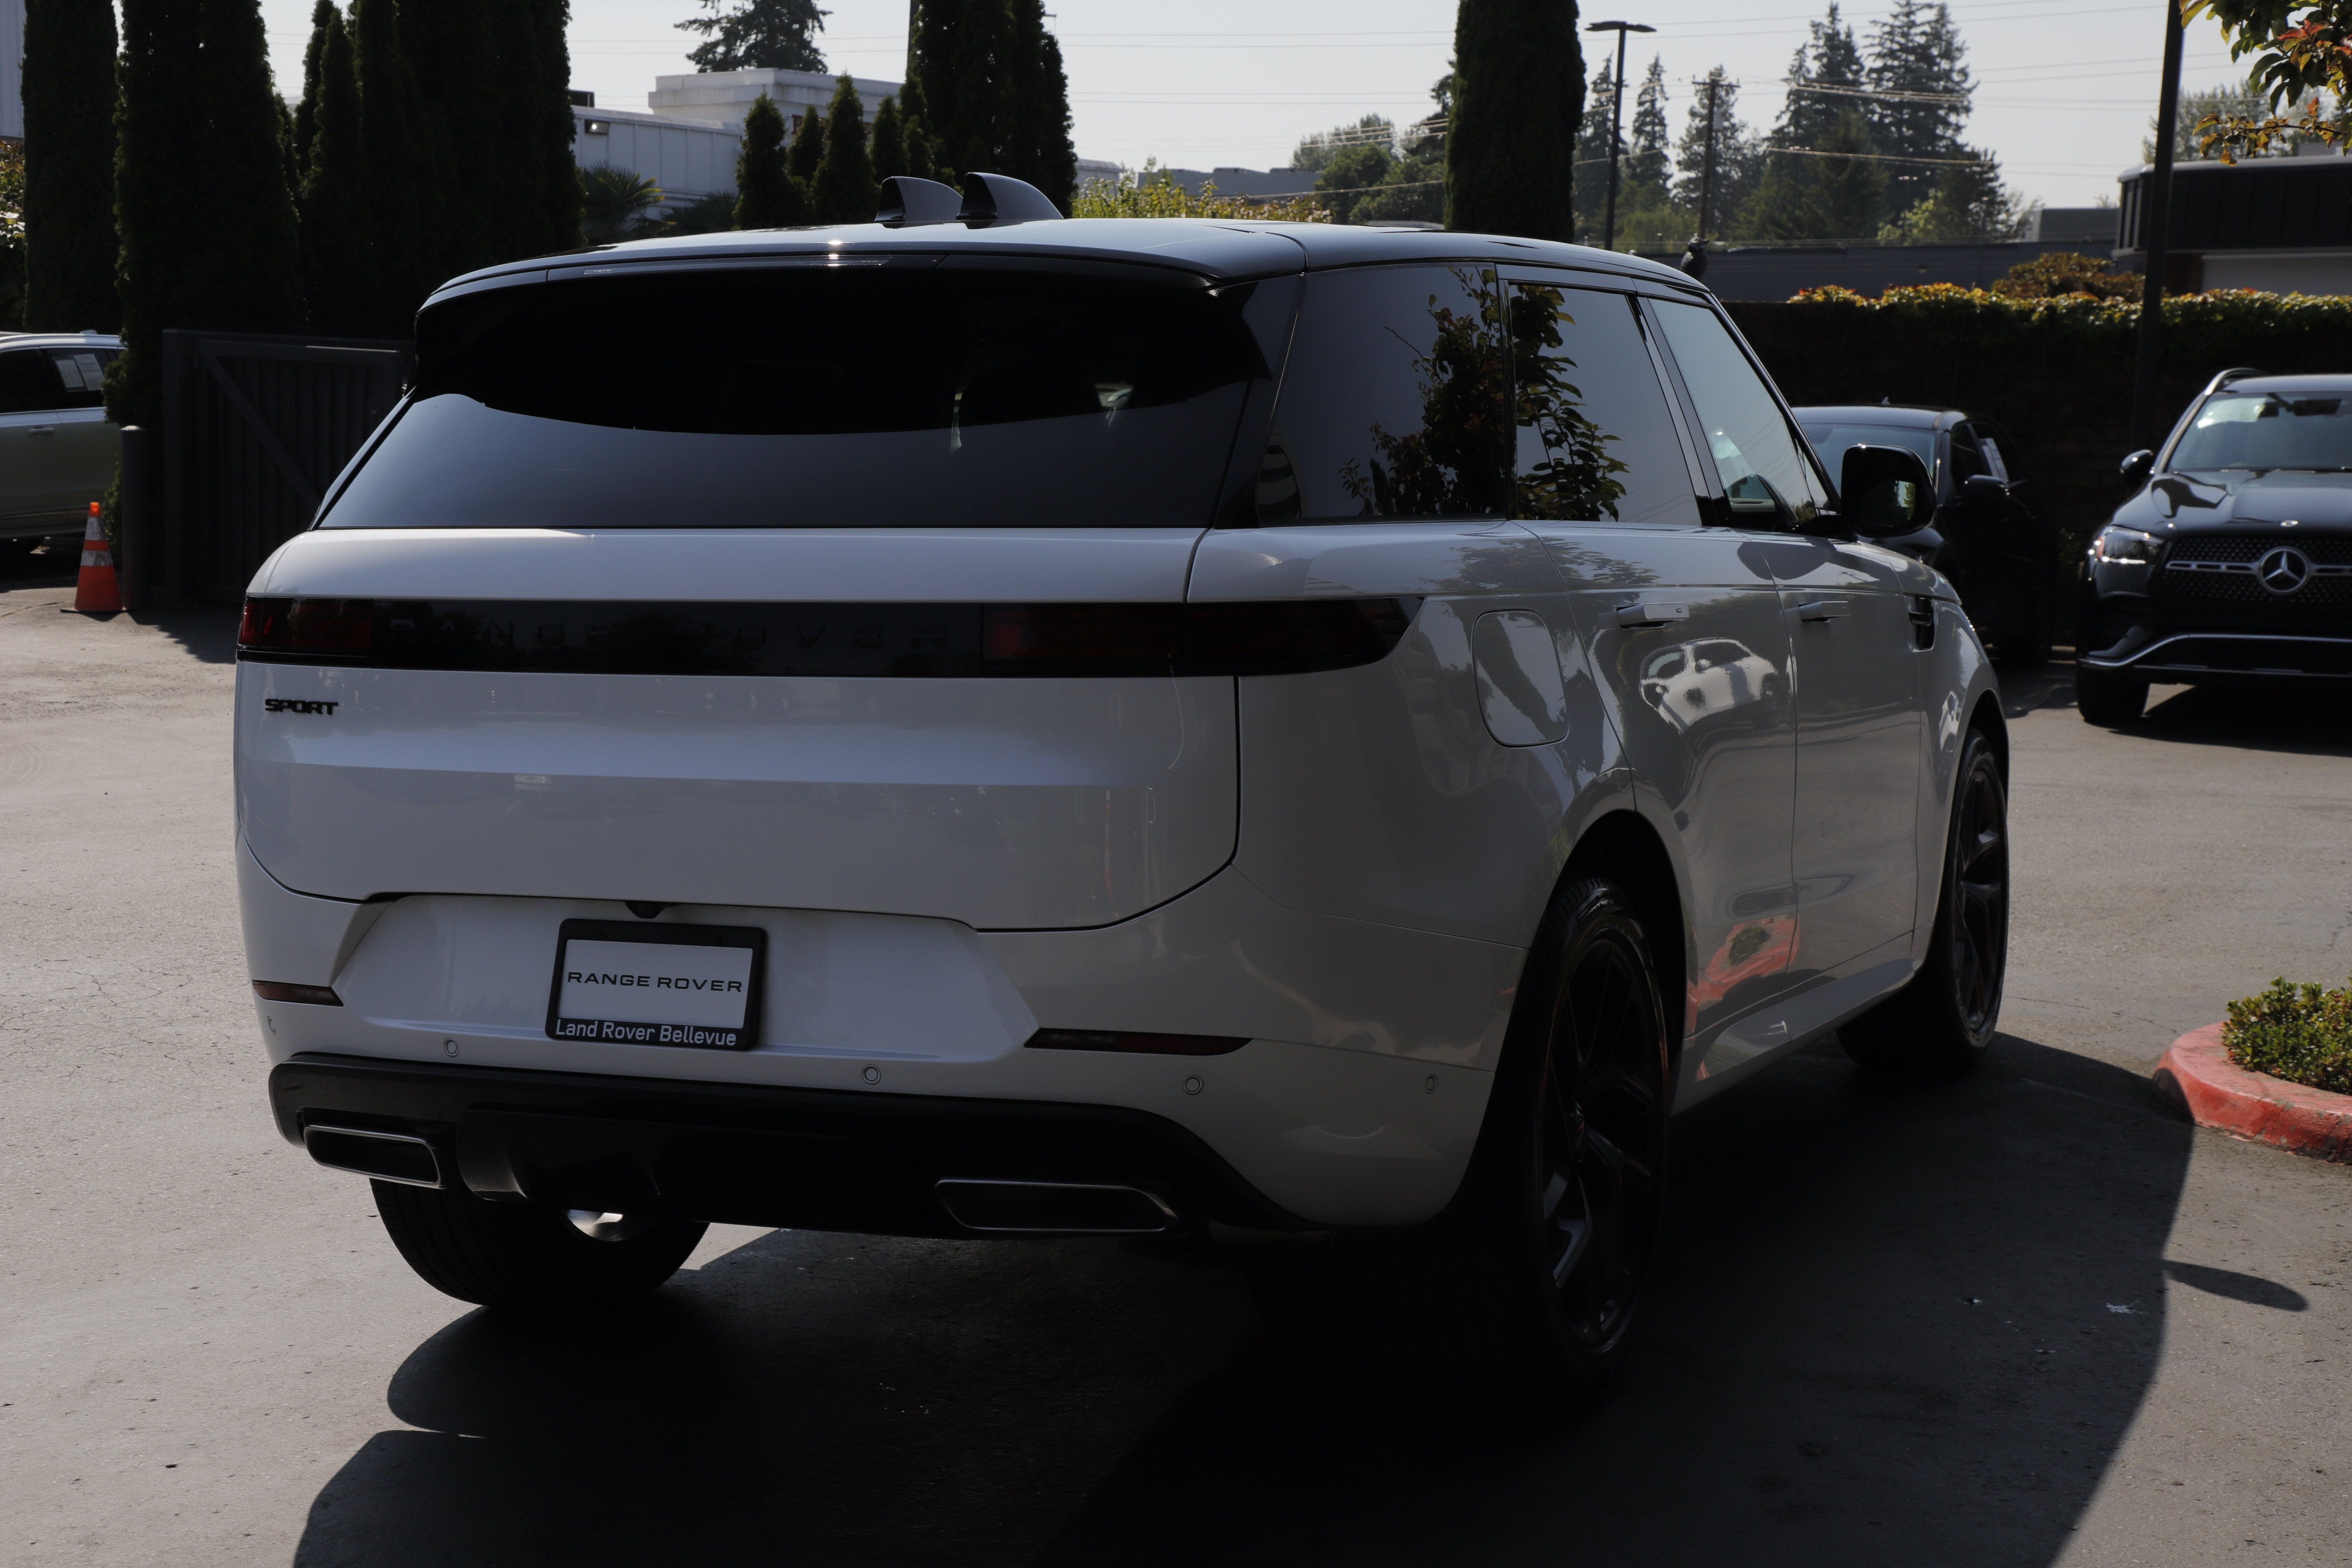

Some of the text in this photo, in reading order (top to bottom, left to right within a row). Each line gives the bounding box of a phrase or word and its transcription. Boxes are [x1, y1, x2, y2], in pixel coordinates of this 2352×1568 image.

[675, 623, 949, 649] ROVER
[265, 698, 339, 715] SPORT
[568, 972, 742, 992] RANGE ROVER
[556, 1019, 737, 1046] Land Rover Bellevue
